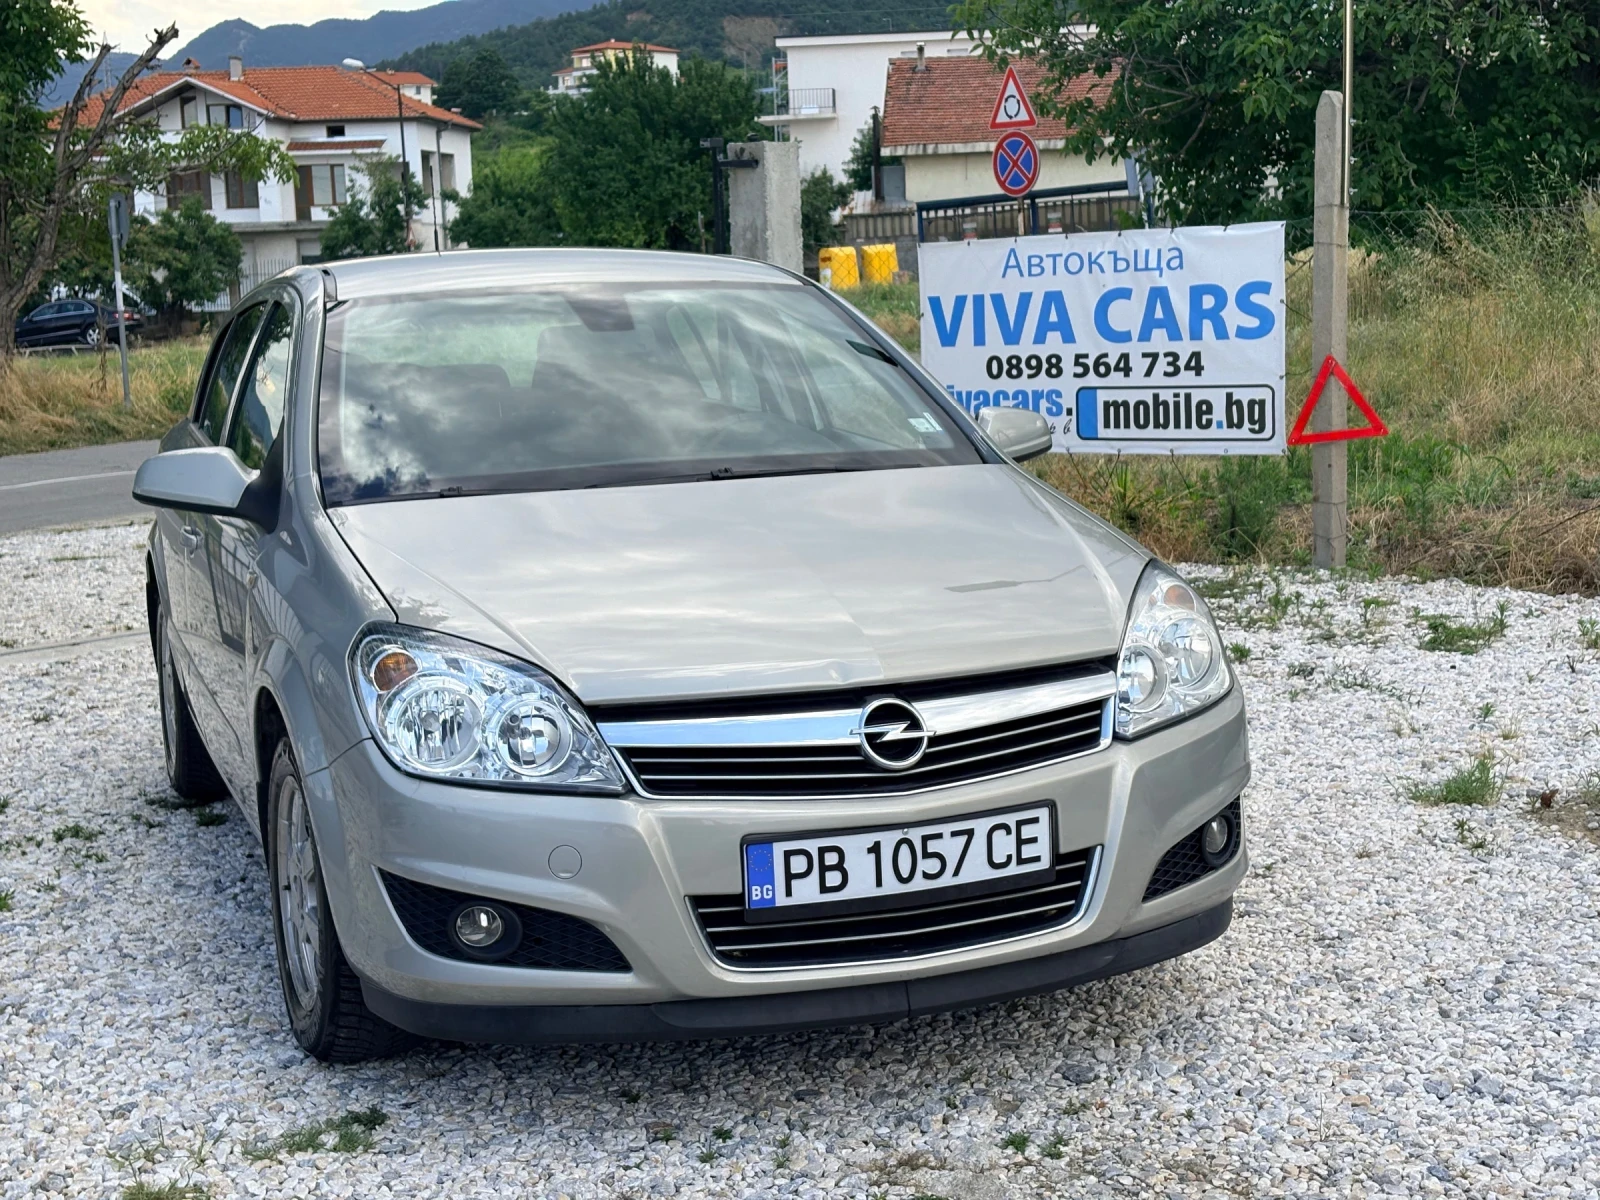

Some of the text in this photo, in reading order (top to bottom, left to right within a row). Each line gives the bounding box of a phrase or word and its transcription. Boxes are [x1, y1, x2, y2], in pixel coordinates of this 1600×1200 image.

[1001, 246, 1184, 278] Автокъща
[928, 281, 1276, 347] VIVA CARS
[986, 351, 1205, 380] 0898 564 734
[1103, 391, 1267, 435] mobile.bg
[783, 816, 1042, 898] PB 1057 CE
[751, 884, 773, 900] BG
